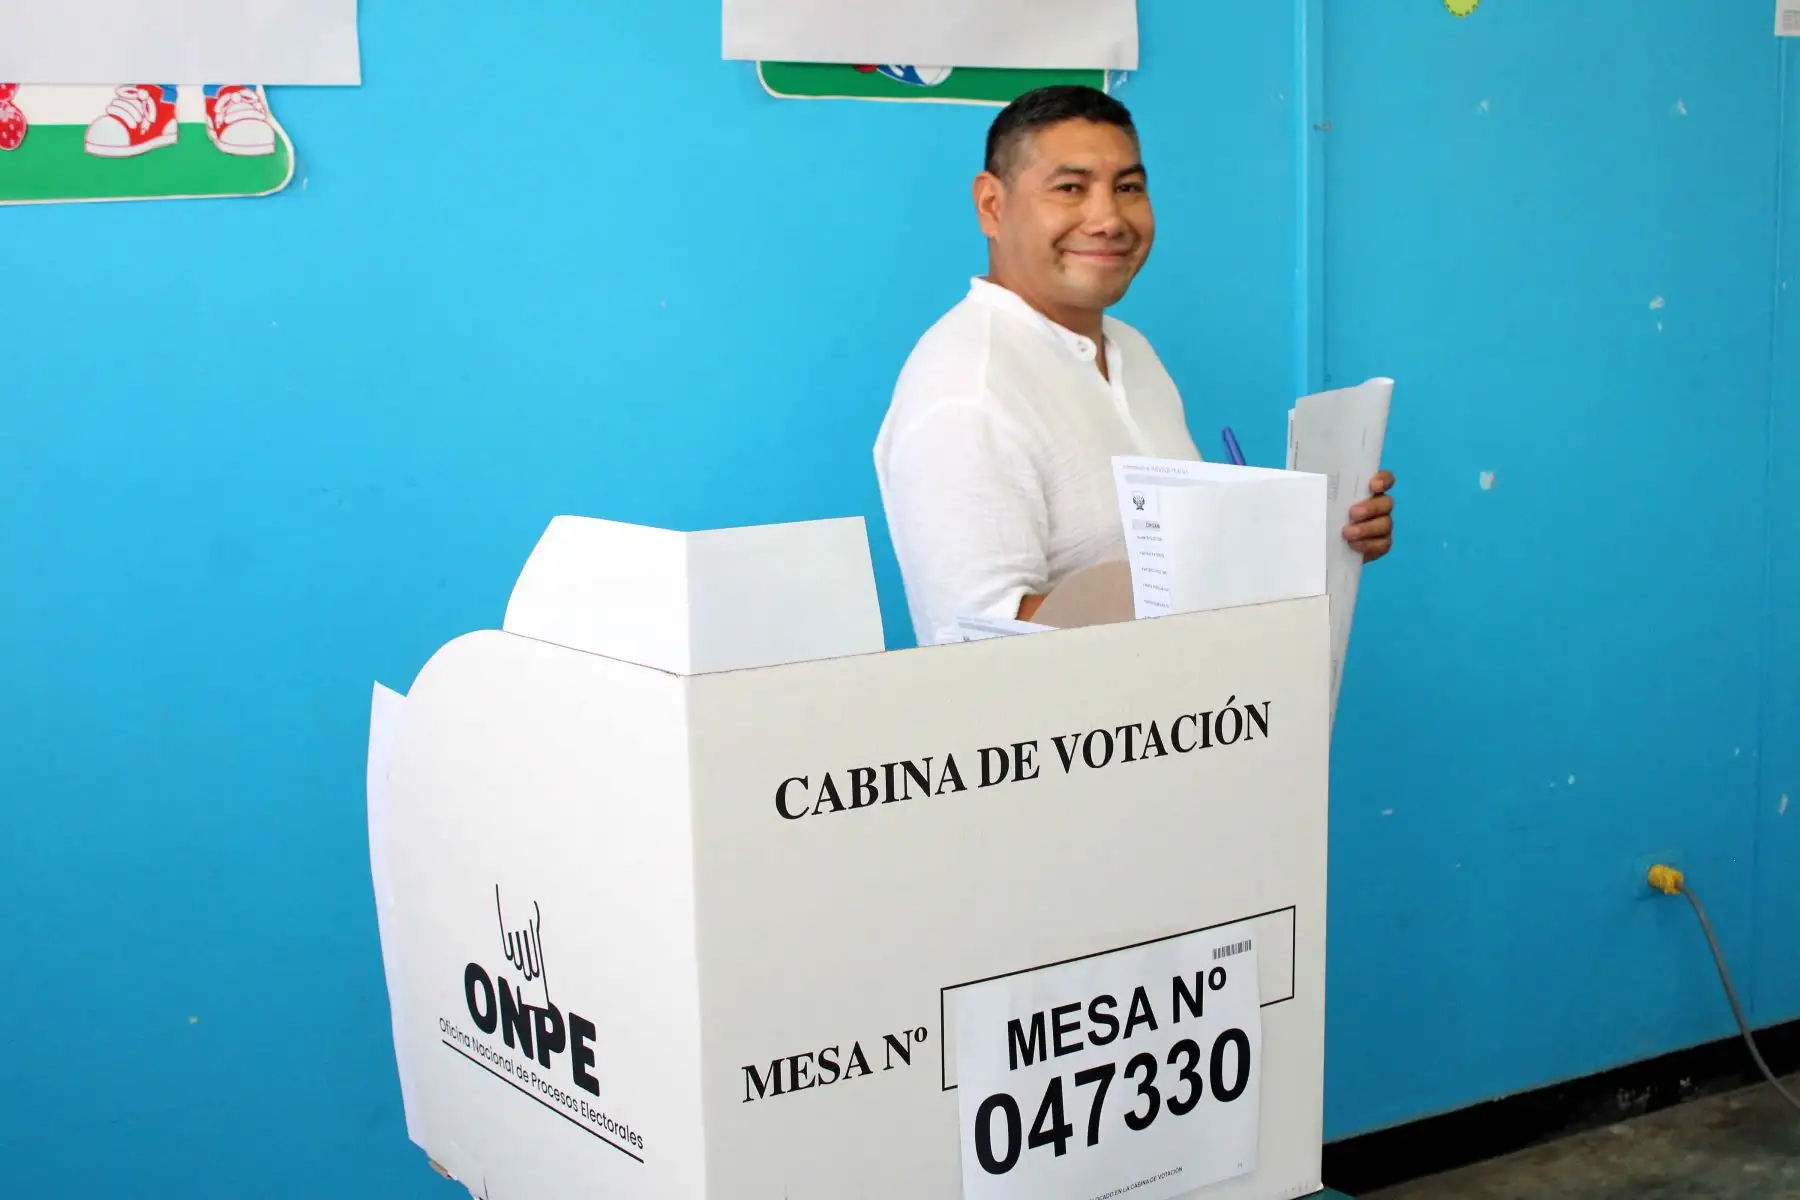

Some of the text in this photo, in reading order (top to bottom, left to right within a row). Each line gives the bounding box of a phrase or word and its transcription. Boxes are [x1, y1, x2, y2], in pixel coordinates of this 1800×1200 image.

[775, 694, 1271, 820] CABINA DE VOTACIÓN
[464, 962, 600, 1097] ONPE
[741, 1026, 928, 1103] MESA Nº
[1007, 966, 1227, 1071] MESA Nº
[439, 1017, 644, 1150] Oficina Nacional de Procesos Electorales
[974, 1028, 1251, 1175] 047330
[1114, 1187, 1122, 1196] EN
[1130, 1178, 1150, 1190] CABINA
